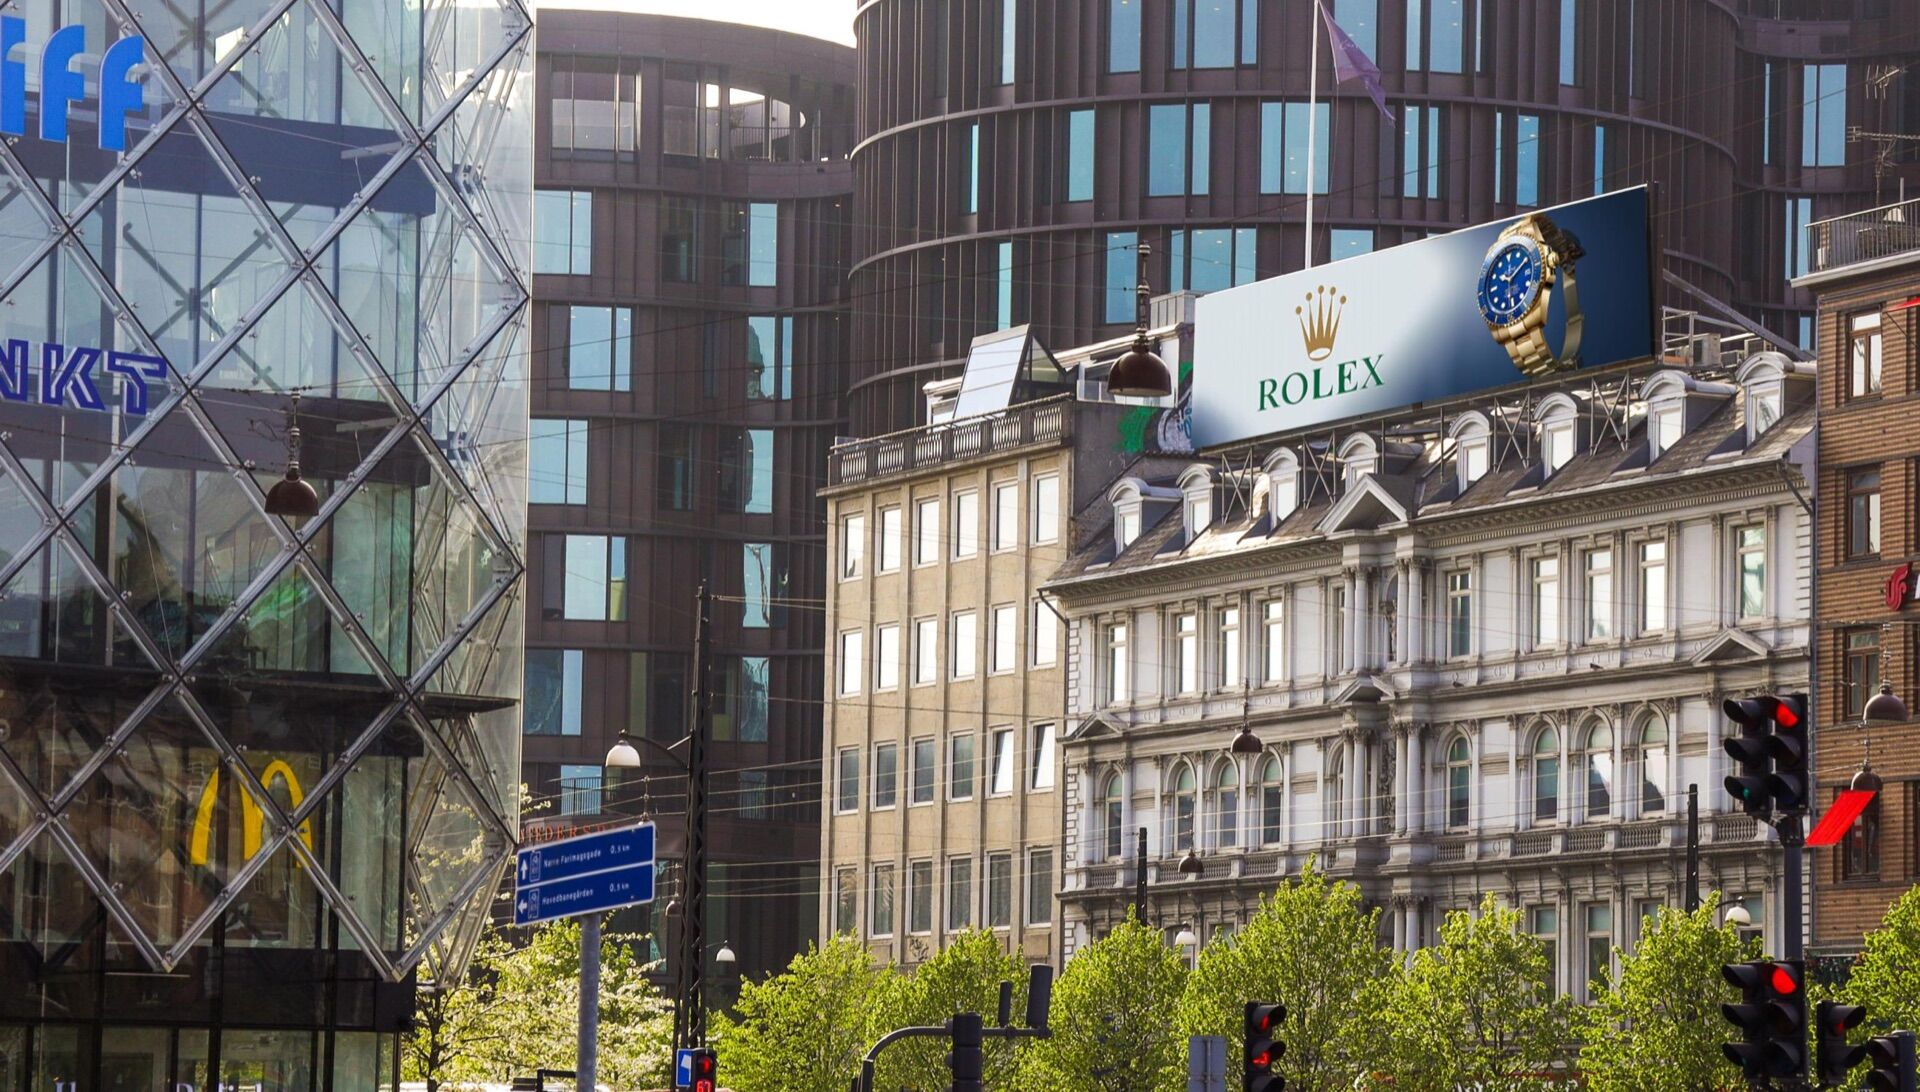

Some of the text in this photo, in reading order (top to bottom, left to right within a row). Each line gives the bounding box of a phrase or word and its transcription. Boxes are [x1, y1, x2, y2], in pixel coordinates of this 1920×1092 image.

[0, 338, 168, 416] NKT
[1257, 353, 1385, 411] ROLEX
[560, 848, 602, 864] Farimagsgade
